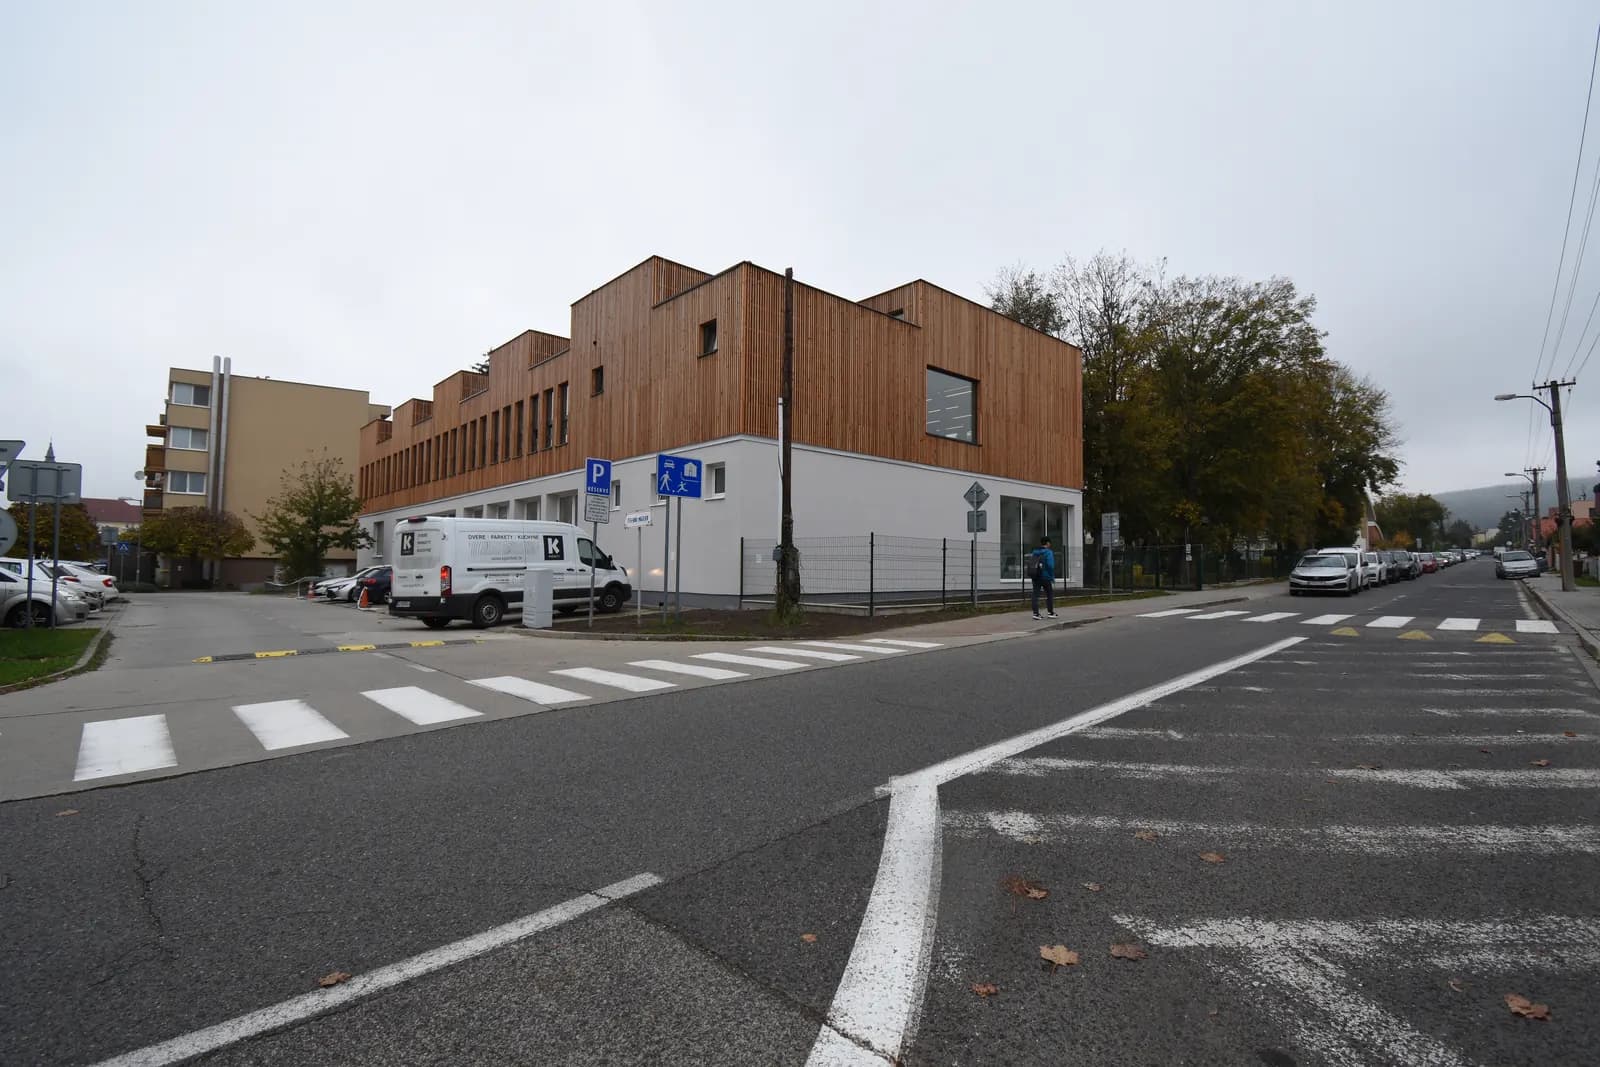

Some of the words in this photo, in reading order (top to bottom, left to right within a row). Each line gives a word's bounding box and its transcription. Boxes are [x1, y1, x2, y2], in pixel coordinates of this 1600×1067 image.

[592, 463, 605, 484] P
[403, 534, 412, 550] K
[547, 537, 560, 554] K
